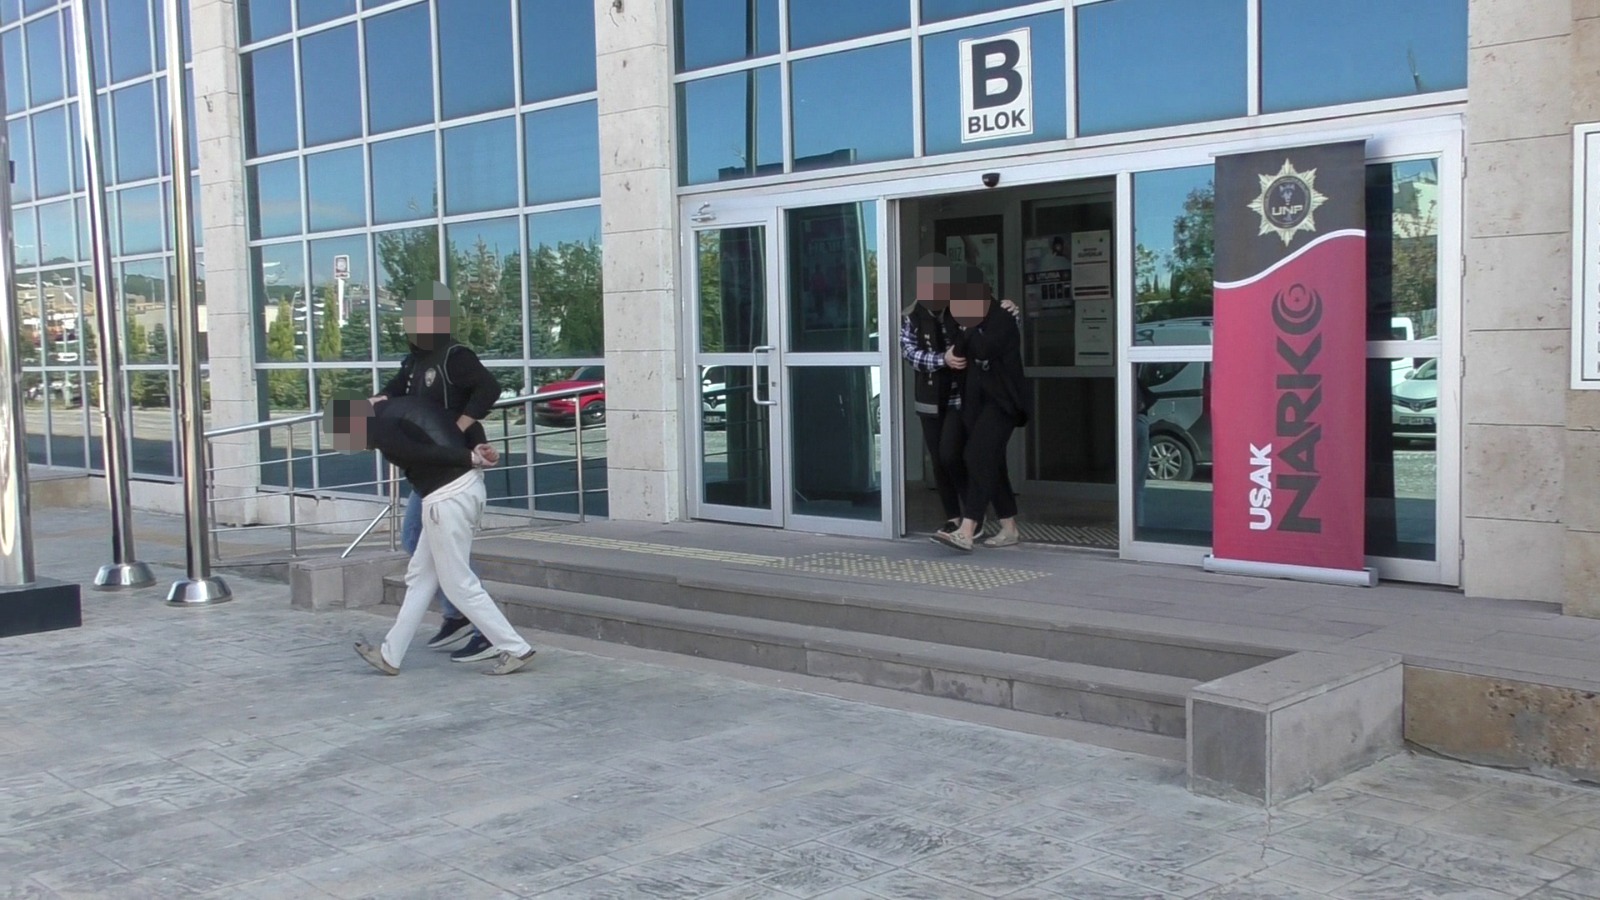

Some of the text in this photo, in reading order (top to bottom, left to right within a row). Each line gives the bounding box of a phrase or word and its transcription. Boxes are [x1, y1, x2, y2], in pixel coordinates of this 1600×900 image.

[971, 38, 1023, 111] B
[968, 108, 1026, 134] BLOK
[1271, 204, 1304, 216] UNP
